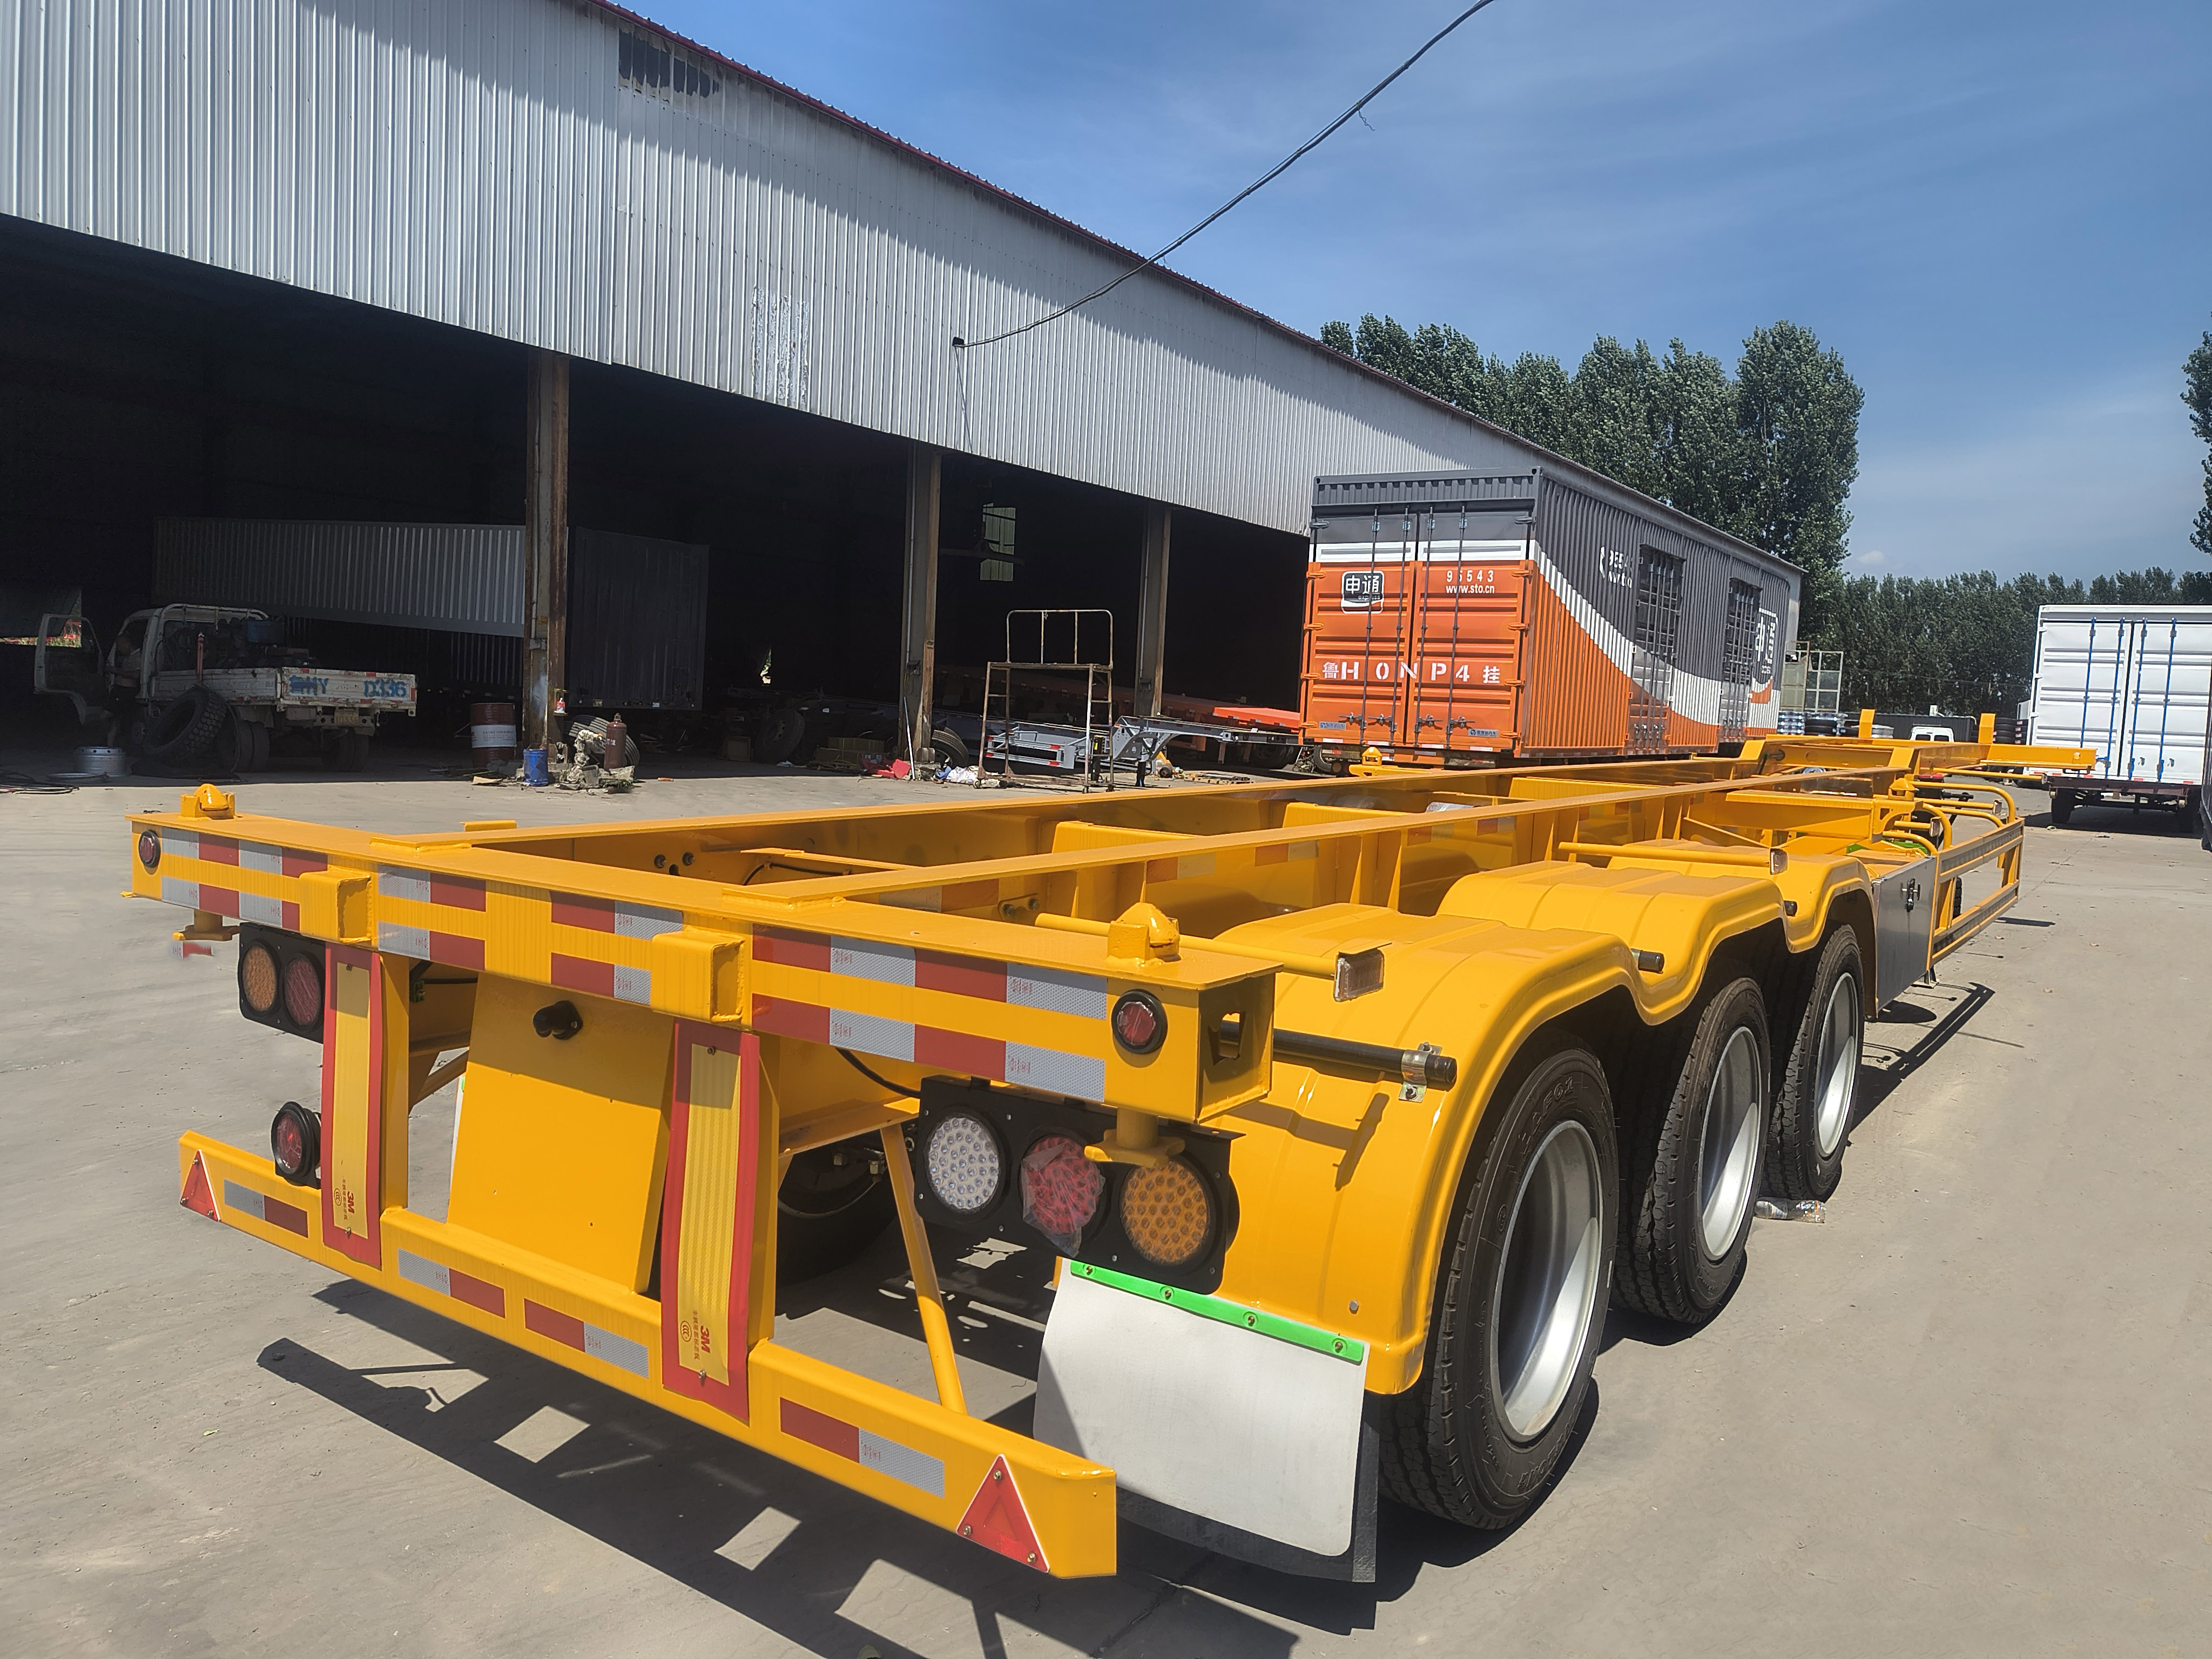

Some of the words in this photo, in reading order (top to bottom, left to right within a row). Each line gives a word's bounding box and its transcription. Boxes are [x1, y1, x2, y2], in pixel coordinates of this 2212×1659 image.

[1345, 575, 1380, 595] 申通
[1446, 583, 1495, 594] www.sto.cn
[347, 1191, 355, 1214] 3M
[700, 1325, 711, 1353] 3M
